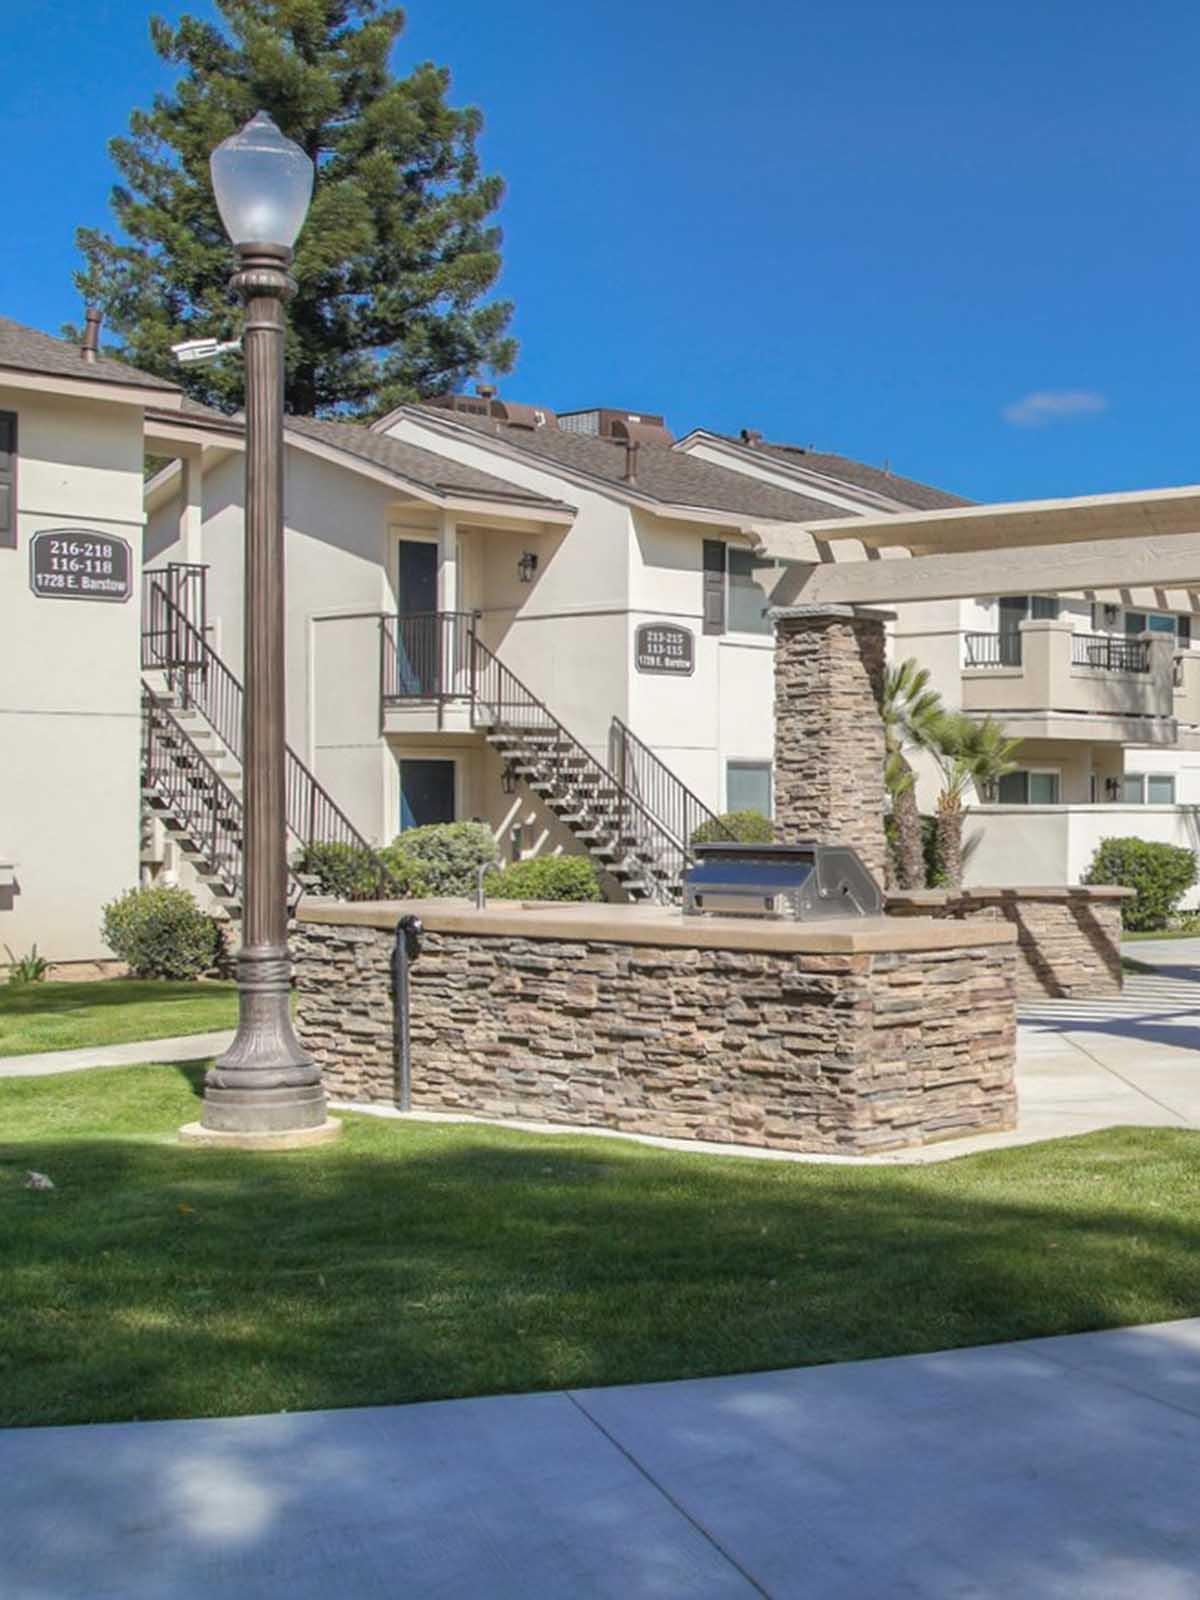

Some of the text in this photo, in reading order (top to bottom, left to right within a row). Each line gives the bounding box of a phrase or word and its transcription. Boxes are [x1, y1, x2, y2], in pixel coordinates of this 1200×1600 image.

[50, 540, 112, 559] 216-218
[51, 557, 112, 574] 116-118
[36, 573, 65, 588] 1728
[81, 576, 126, 592] Barstow
